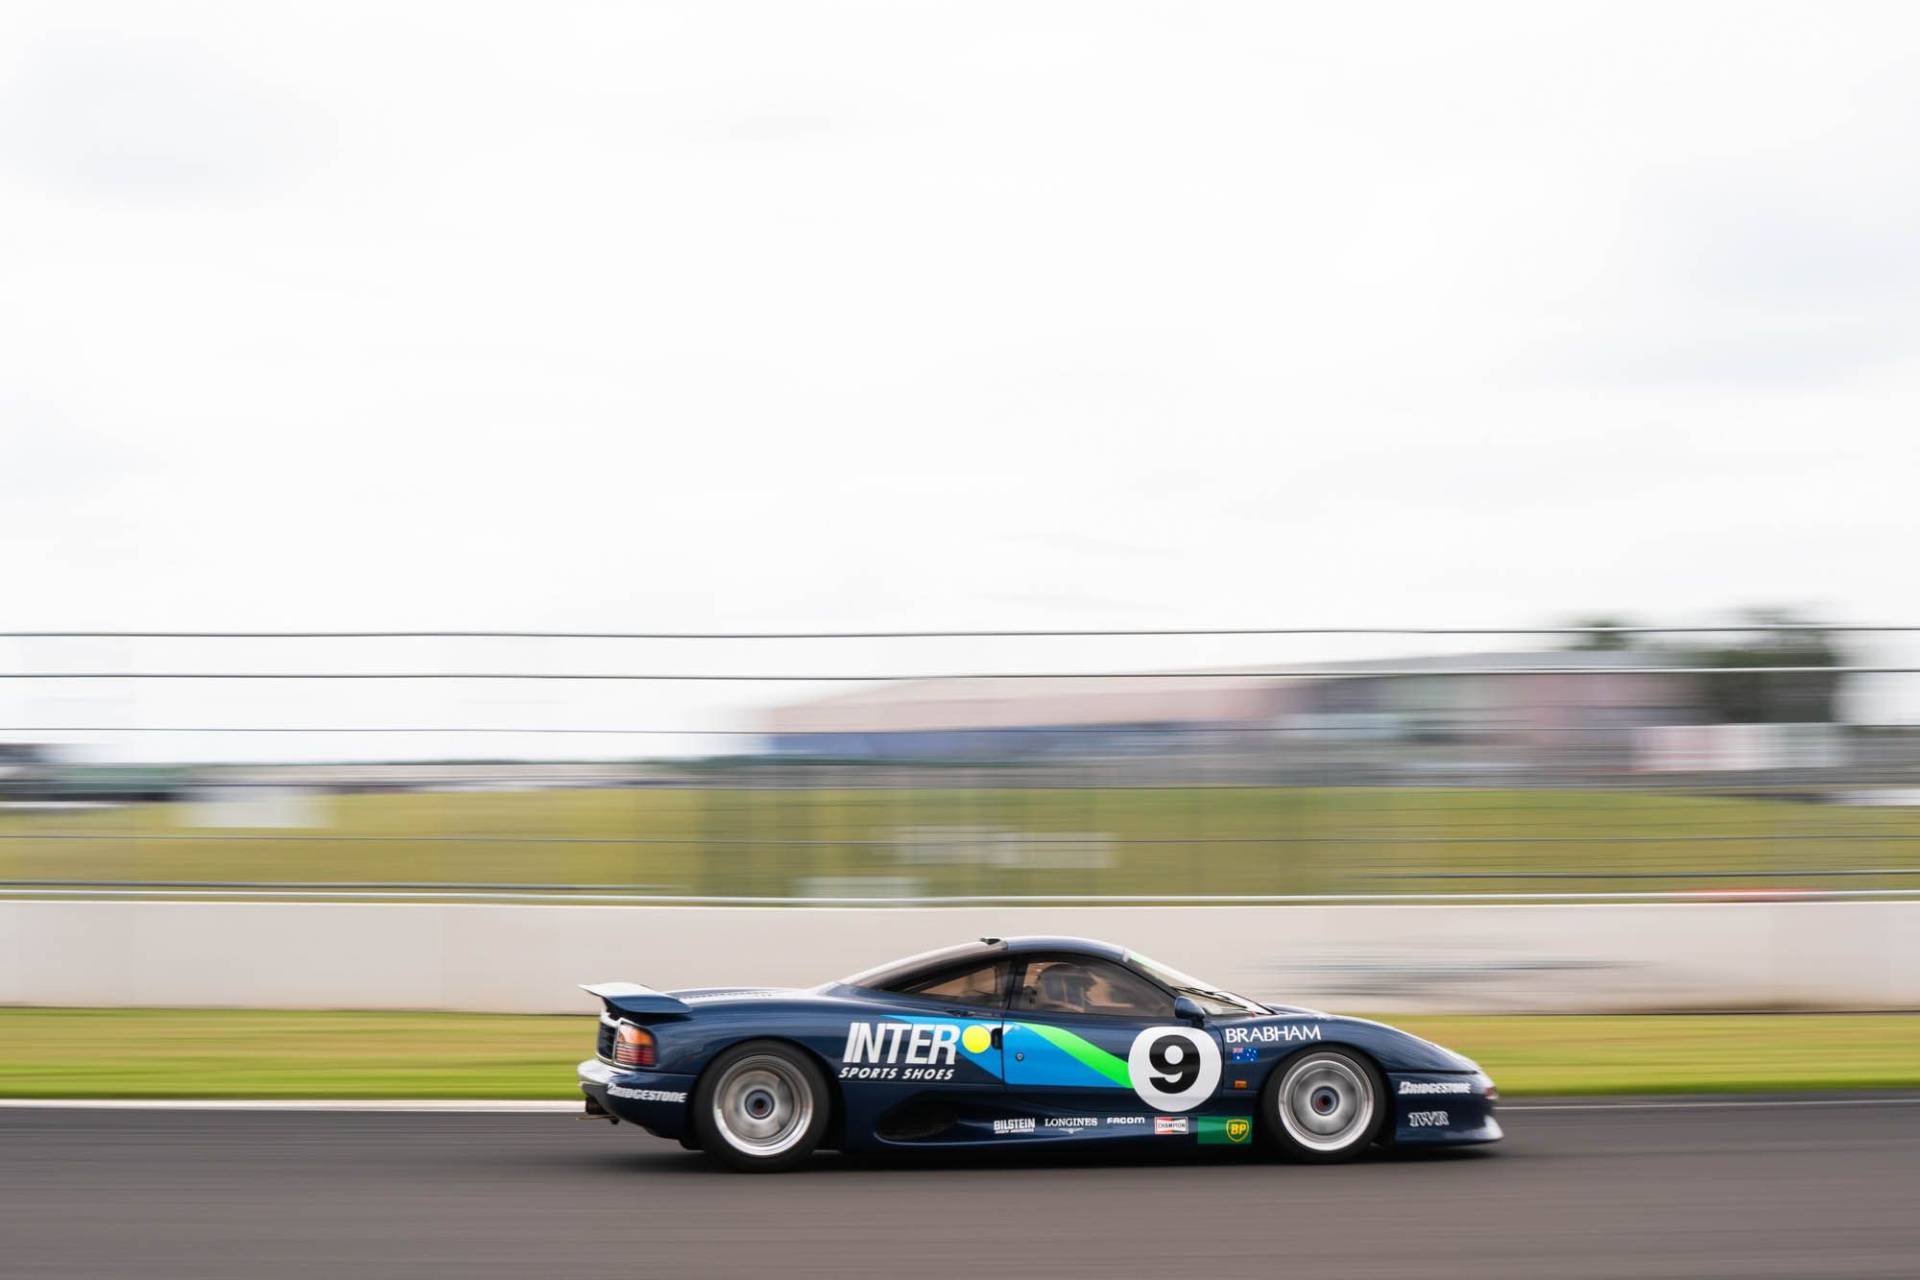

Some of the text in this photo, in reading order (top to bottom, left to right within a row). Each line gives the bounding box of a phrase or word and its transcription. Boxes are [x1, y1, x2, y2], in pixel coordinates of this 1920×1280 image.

[1225, 1025, 1321, 1043] BRABHAM
[842, 1022, 961, 1064] INTER
[1148, 1034, 1201, 1094] 9
[838, 1067, 955, 1080] SPORTS SHOES
[1398, 1081, 1471, 1095] BRIDGESTONE
[993, 1118, 1035, 1130] BILSTEIN
[1044, 1117, 1098, 1127] LONGINES
[1230, 1123, 1247, 1135] BP
